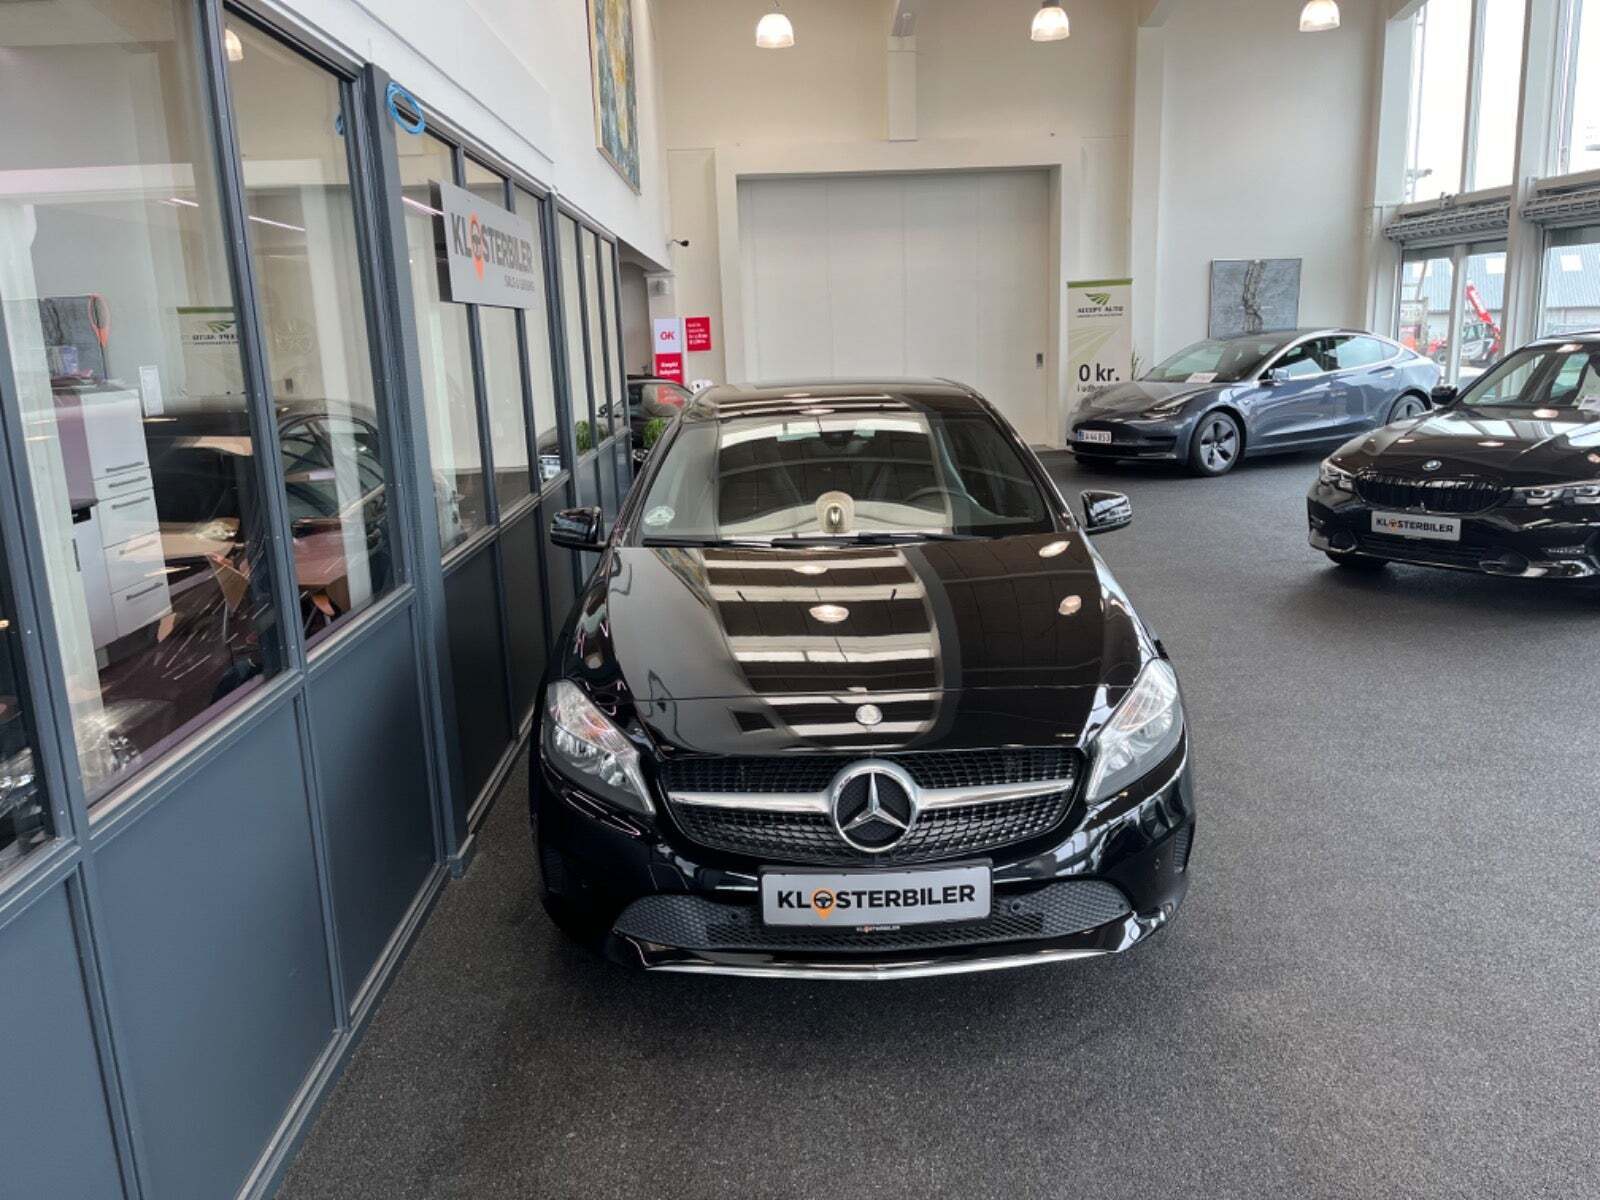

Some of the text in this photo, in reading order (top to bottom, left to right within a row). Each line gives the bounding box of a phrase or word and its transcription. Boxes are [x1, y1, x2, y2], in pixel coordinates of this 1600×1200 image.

[1079, 362, 1120, 381] 0 kr.
[1376, 518, 1454, 533] KLOSTERBILER
[777, 884, 977, 909] KLOSTERBILER
